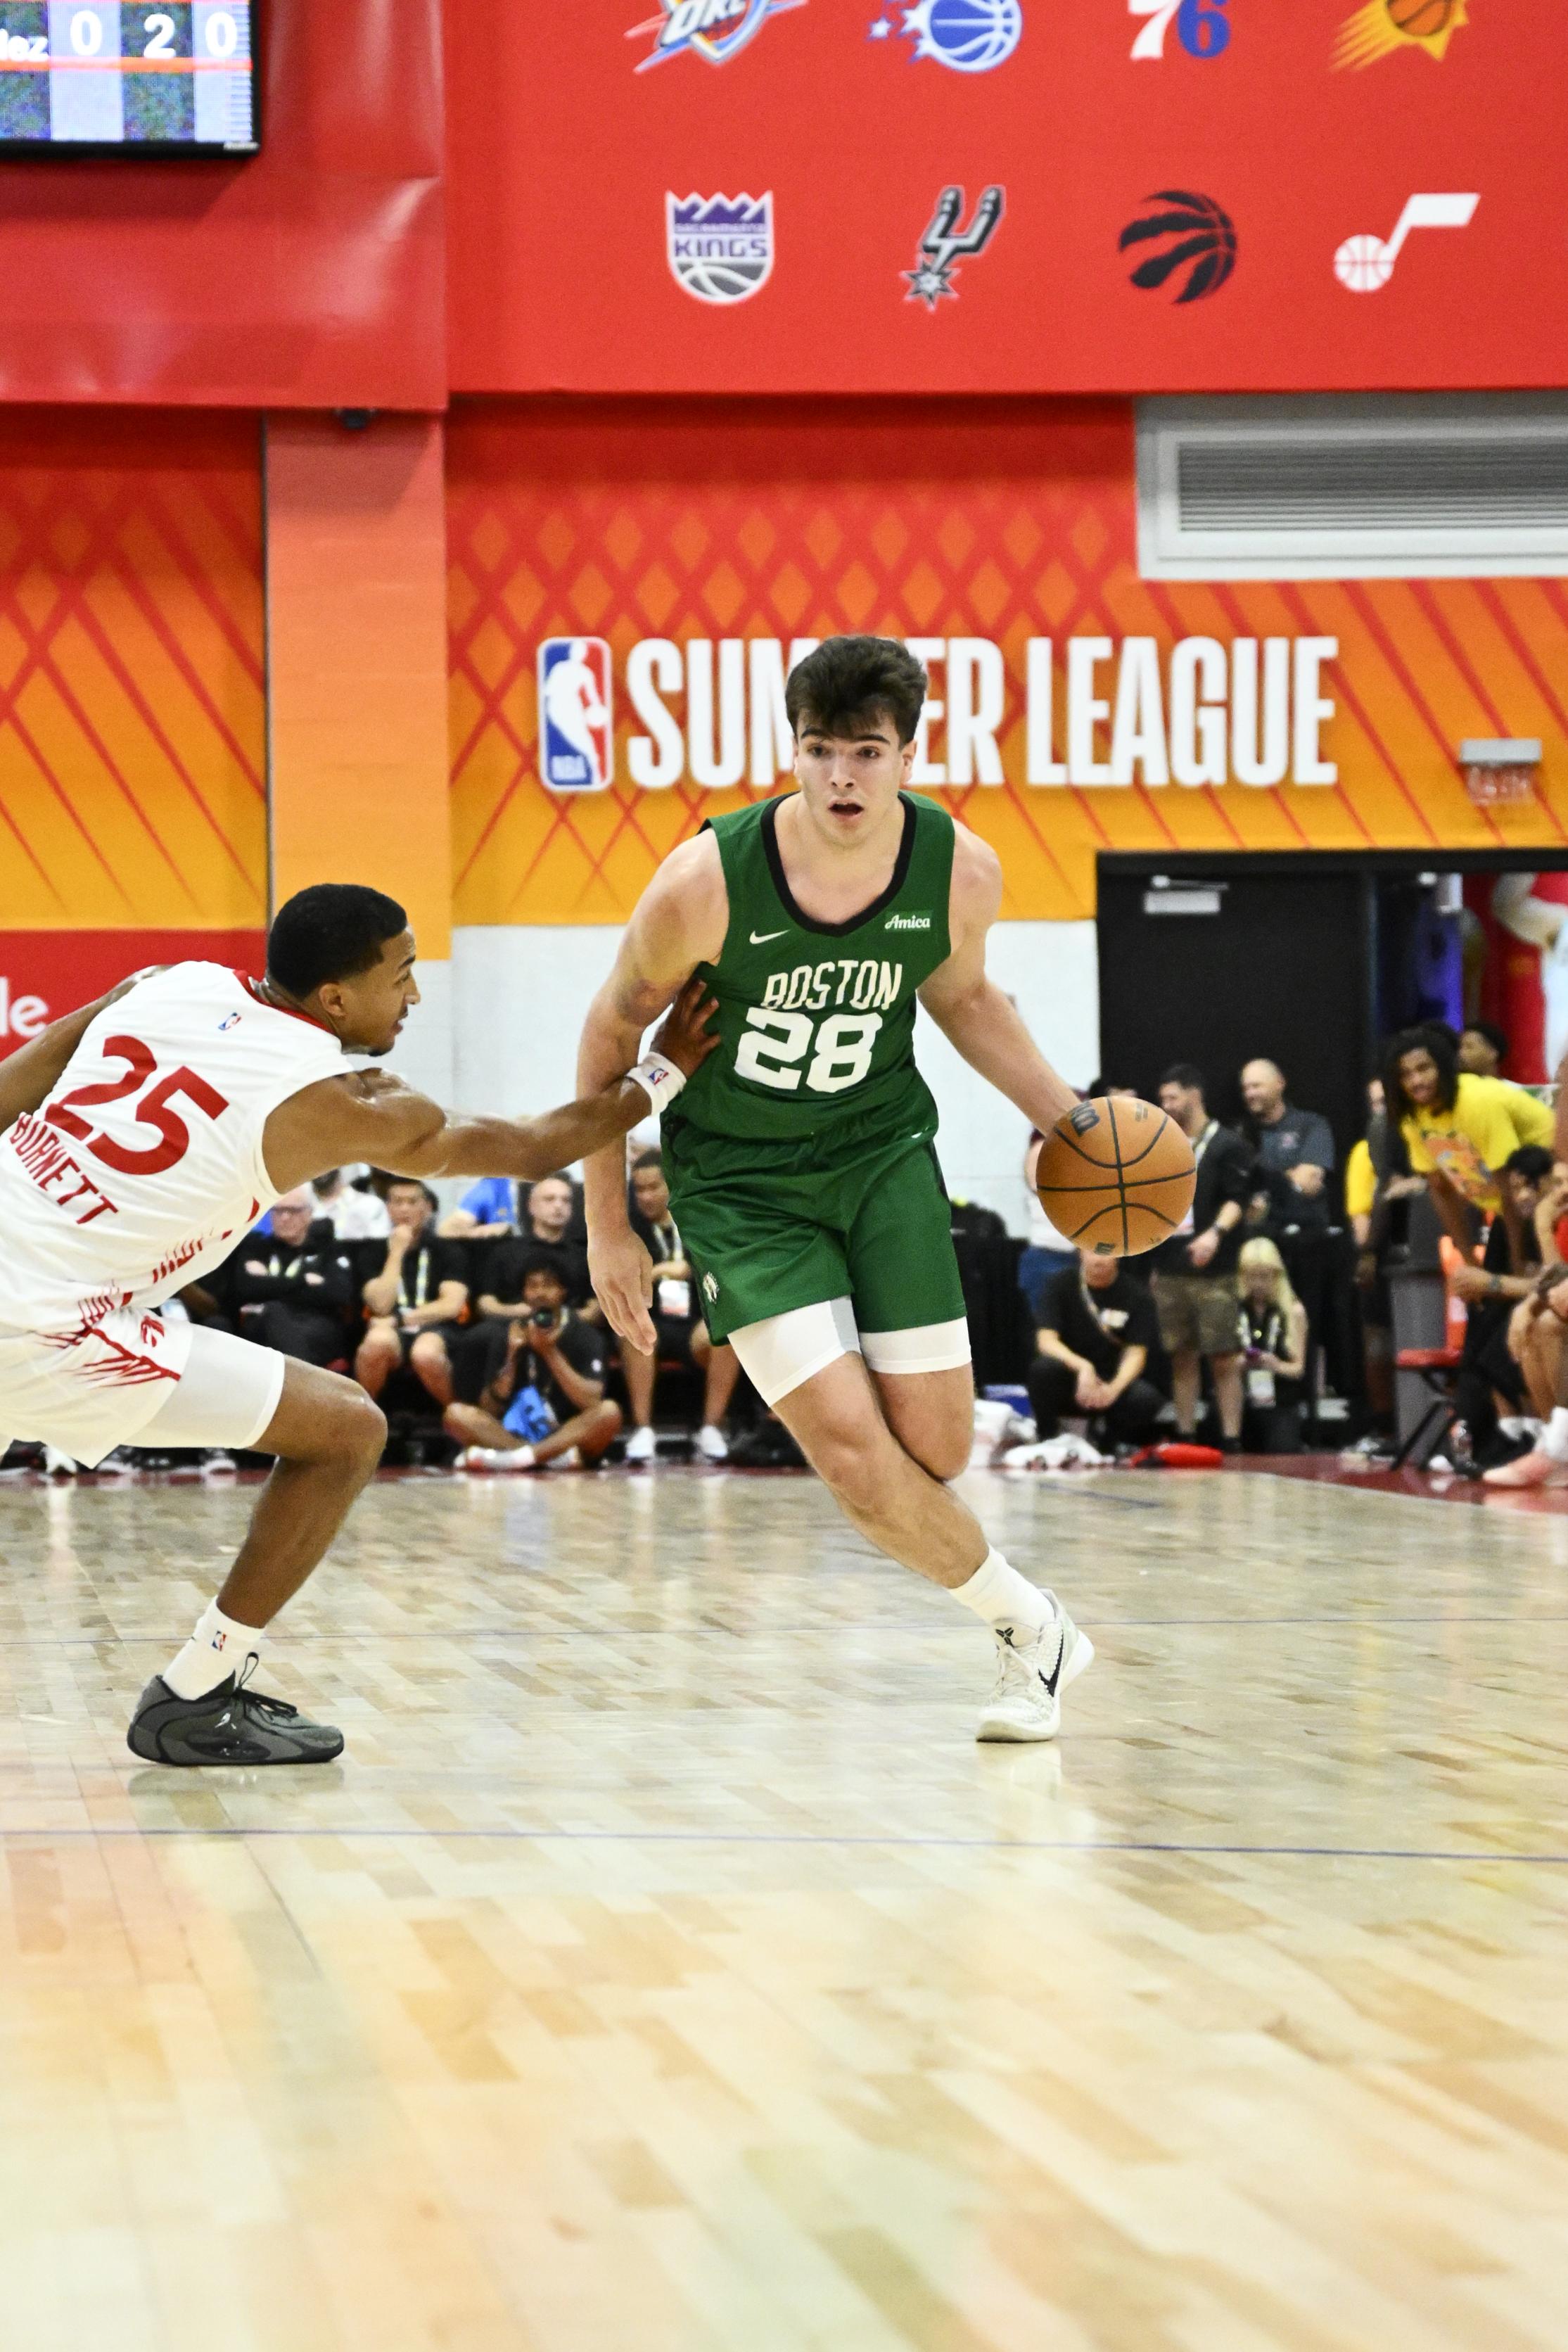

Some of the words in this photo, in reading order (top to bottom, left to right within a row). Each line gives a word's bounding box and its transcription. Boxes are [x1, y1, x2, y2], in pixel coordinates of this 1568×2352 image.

[70, 9, 103, 56] 0
[143, 13, 177, 59] 2
[204, 11, 238, 58] 0
[1127, 0, 1230, 61] 76
[673, 237, 768, 258] KINGS
[626, 637, 1006, 788] SUMER
[1026, 635, 1339, 787] LEAGUE
[884, 914, 931, 929] Amica
[760, 959, 904, 1011] BOSTON
[733, 1006, 884, 1094] 28
[44, 1034, 230, 1176] 25
[9, 1114, 119, 1225] BURNETT
